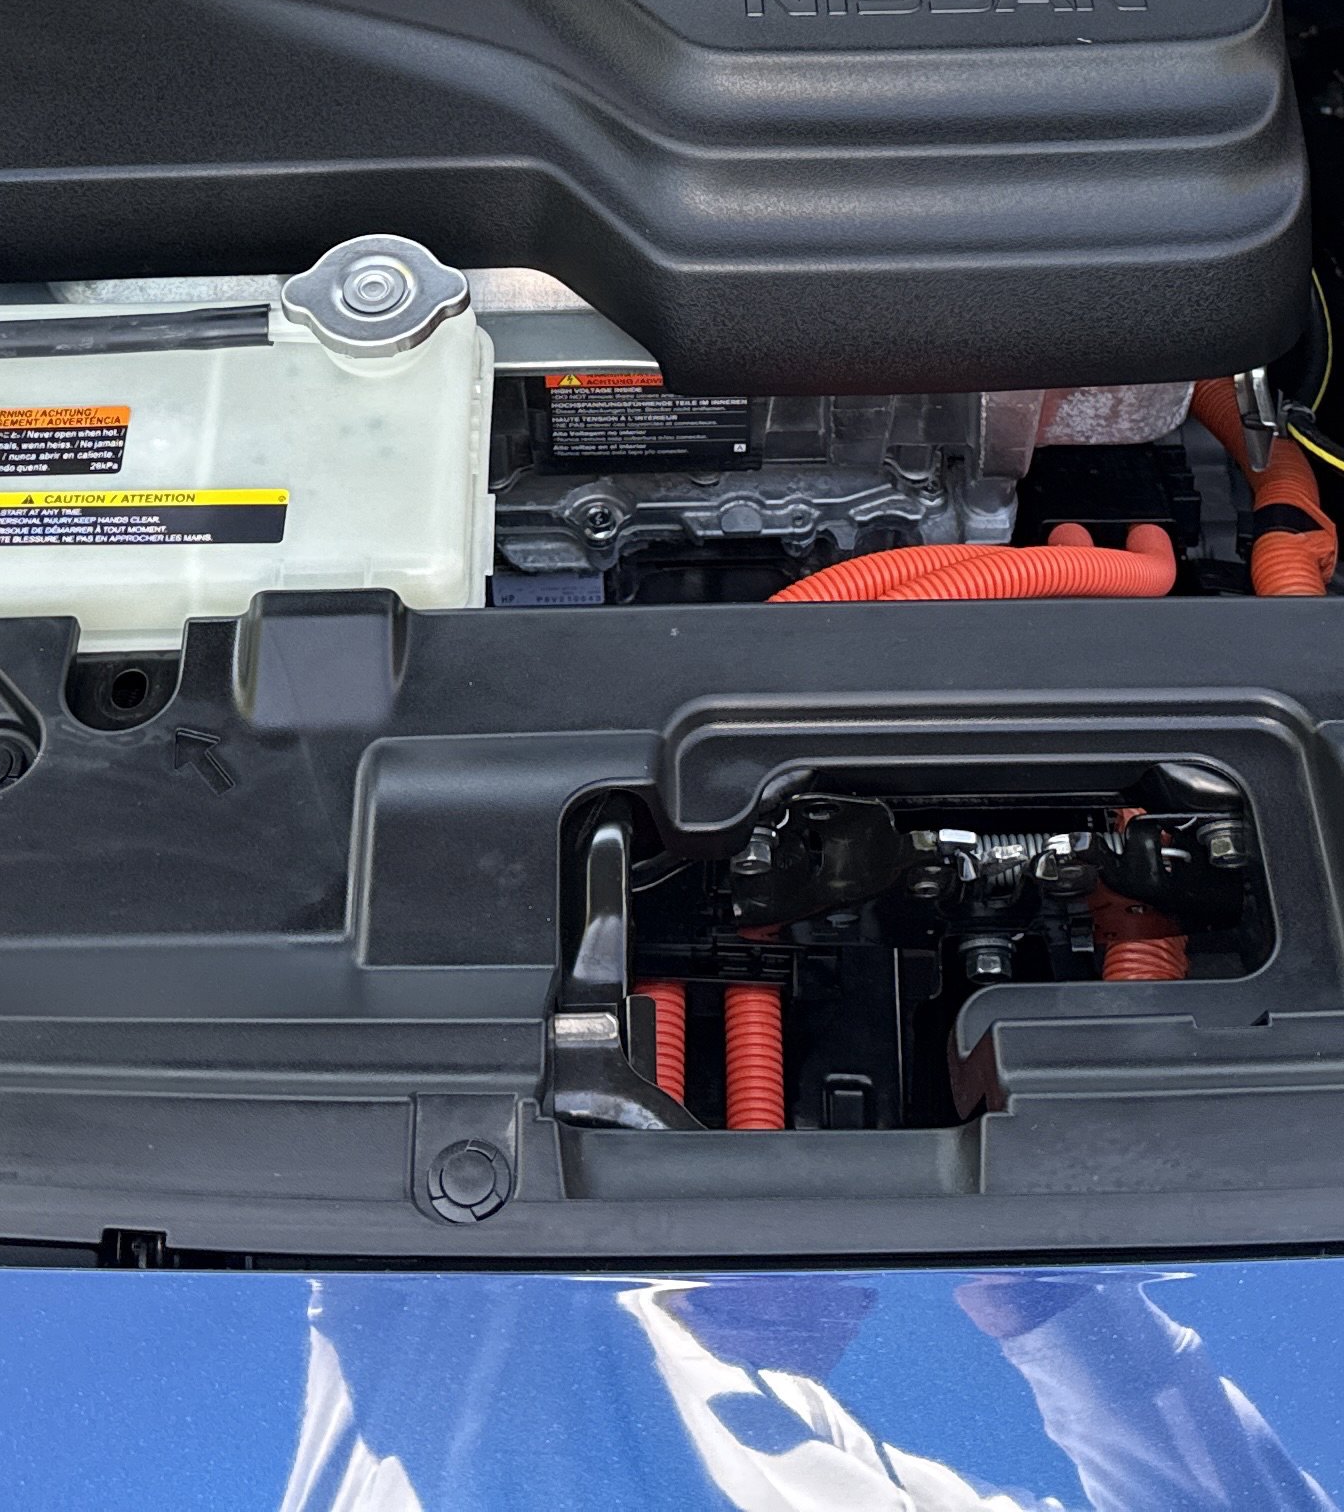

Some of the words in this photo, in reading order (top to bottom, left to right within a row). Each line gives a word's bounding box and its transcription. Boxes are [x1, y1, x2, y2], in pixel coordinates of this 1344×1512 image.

[40, 408, 93, 418] ACHTUNG
[26, 430, 54, 439] Never
[54, 430, 76, 439] open
[77, 429, 102, 437] when
[80, 440, 93, 448] Ne
[93, 440, 124, 449] jamais
[8, 453, 36, 461] nunca
[38, 452, 61, 460] abrir
[44, 494, 106, 504] CAUTION
[120, 493, 196, 503] ATTENTION
[97, 516, 129, 524] HANDS
[31, 526, 44, 534] DE
[61, 535, 75, 543] NE
[75, 535, 94, 543] PAS
[94, 535, 108, 543] EN
[108, 534, 164, 542] APPROCHER
[165, 534, 182, 542] LES
